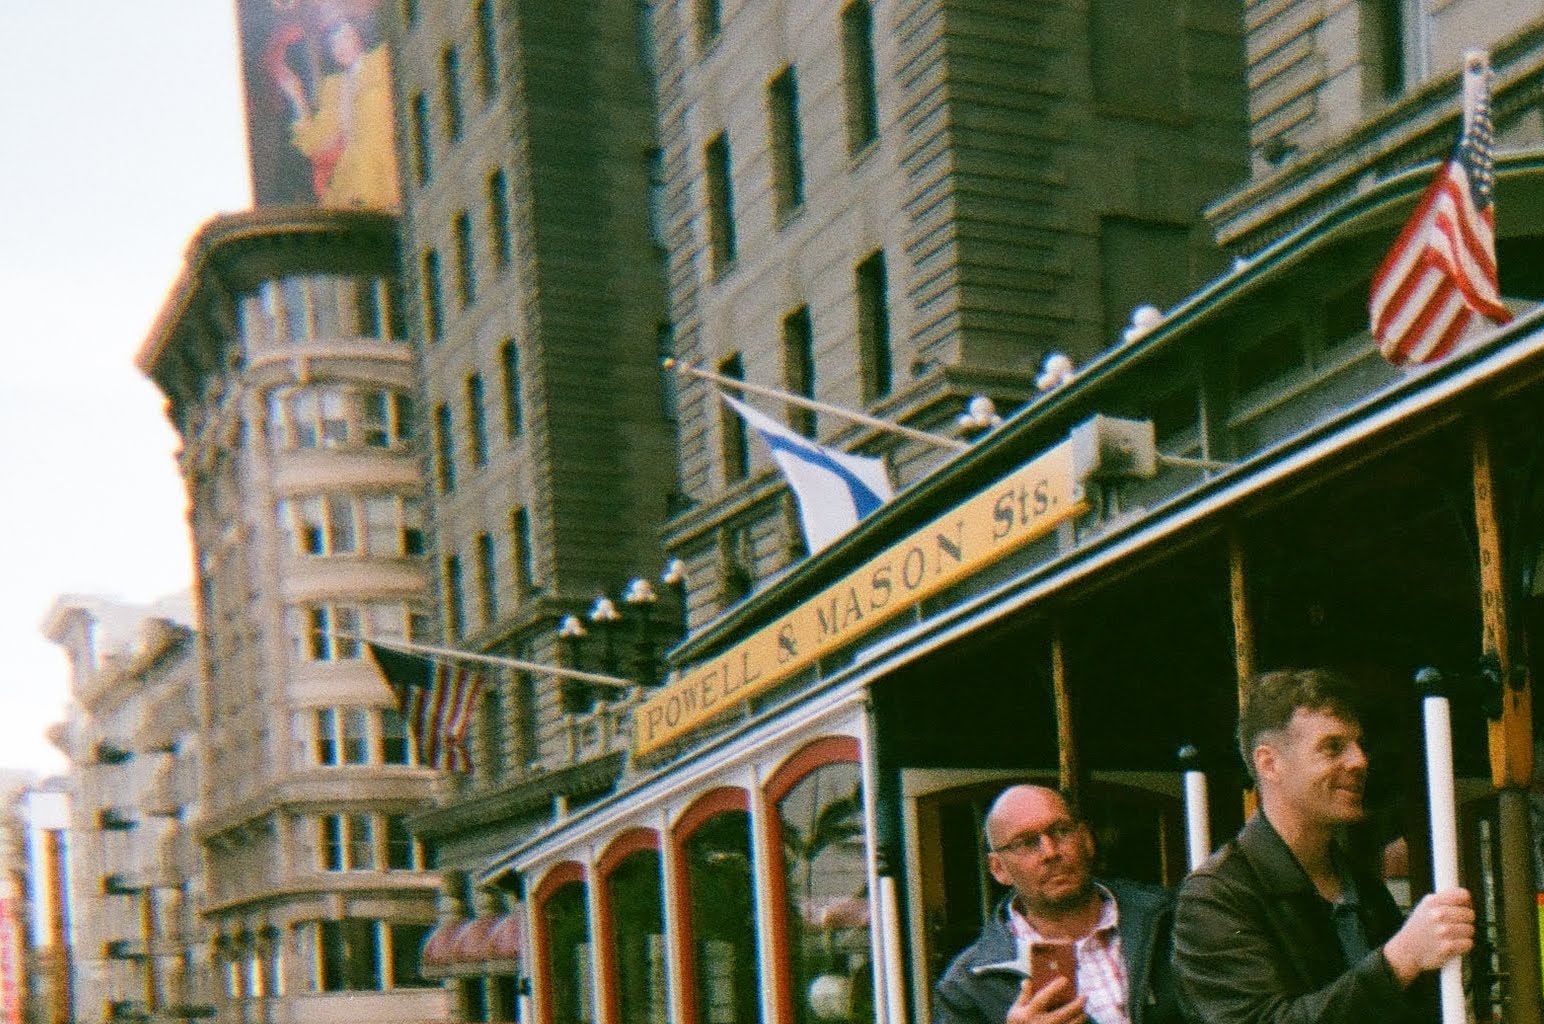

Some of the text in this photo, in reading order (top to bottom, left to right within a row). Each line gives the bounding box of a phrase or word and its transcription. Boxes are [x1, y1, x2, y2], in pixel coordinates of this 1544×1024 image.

[645, 478, 1058, 742] POWELL & MASON Sts.
